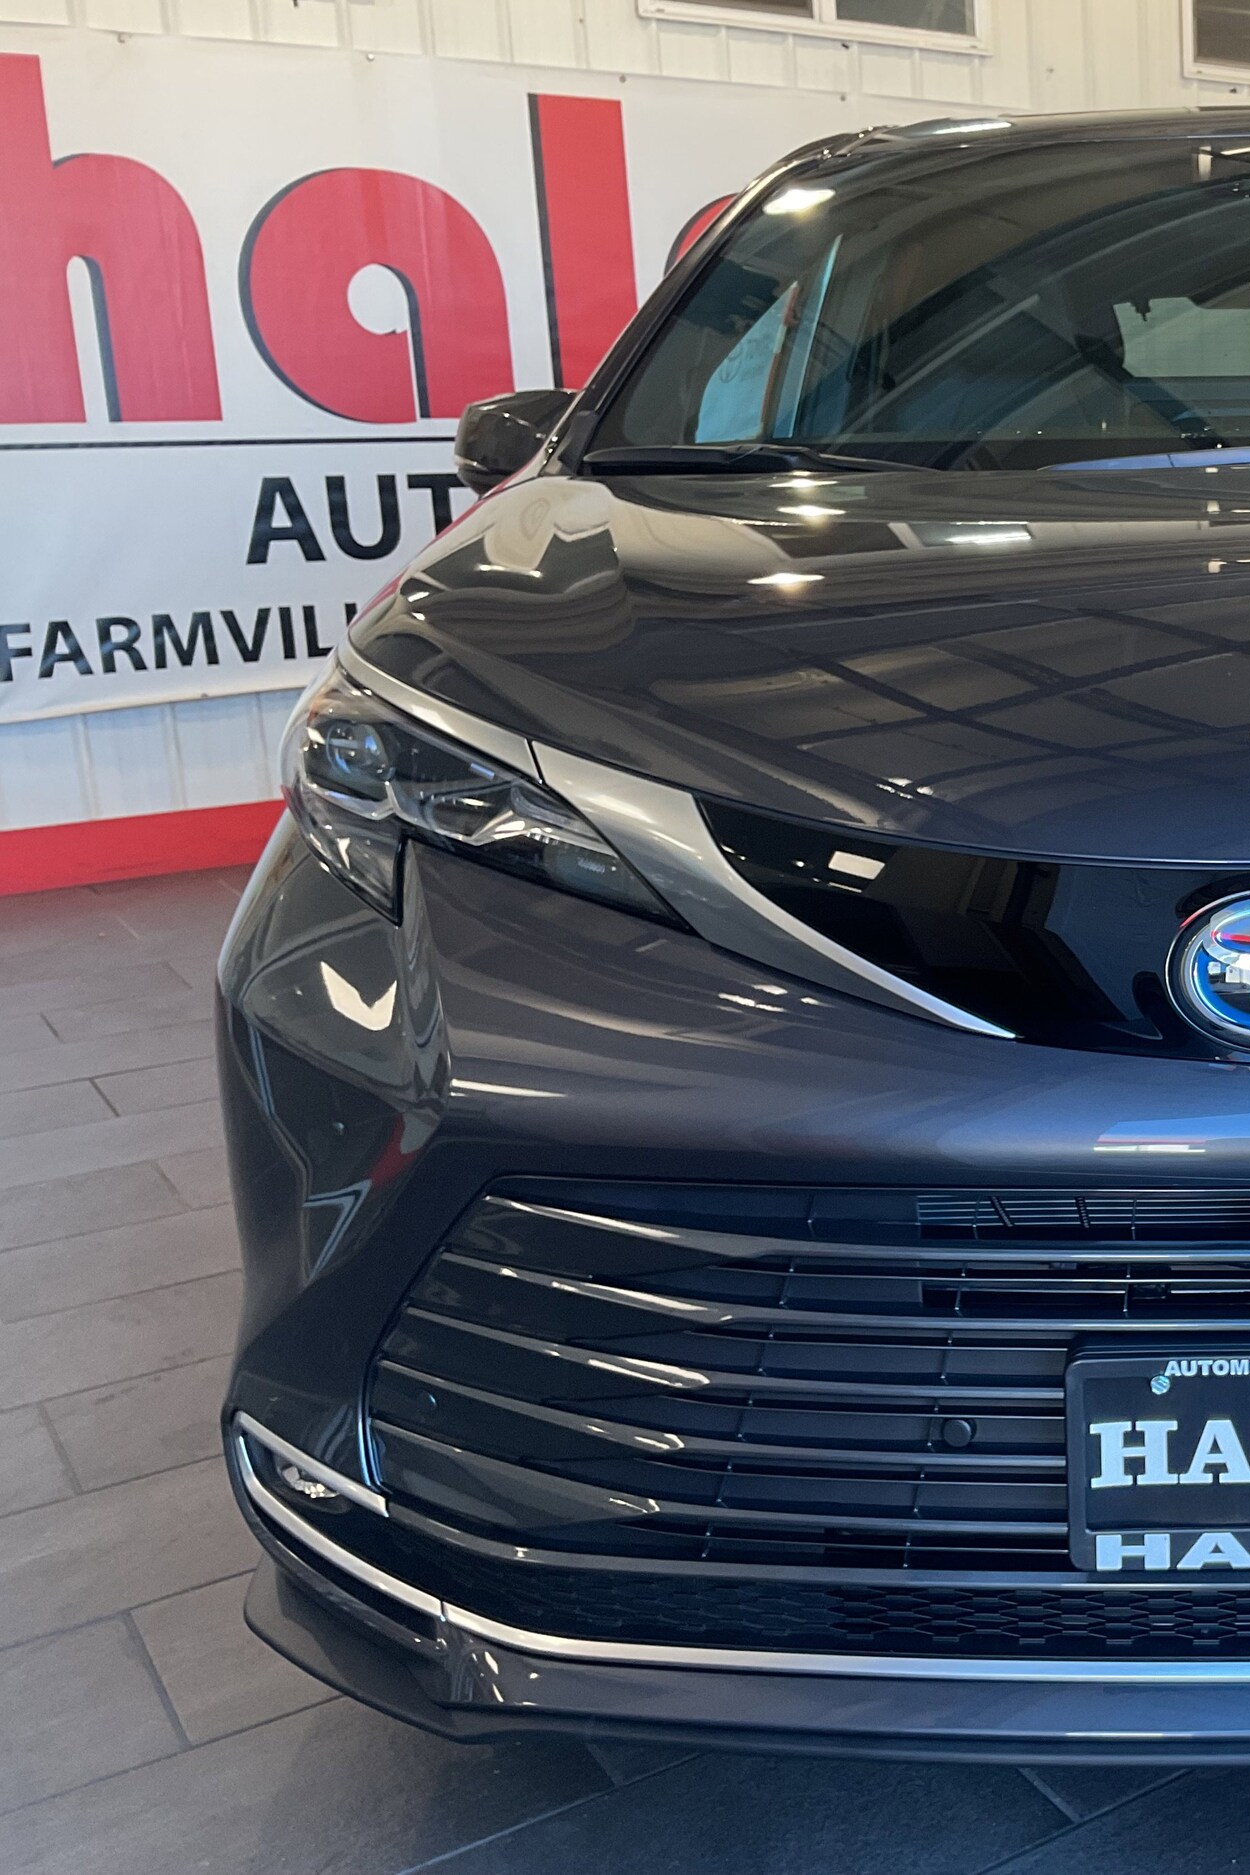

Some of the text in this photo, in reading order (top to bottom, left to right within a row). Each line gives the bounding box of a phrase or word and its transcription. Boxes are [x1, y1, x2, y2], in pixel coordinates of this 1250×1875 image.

[0, 54, 738, 424] hal
[246, 473, 468, 565] AUT
[0, 603, 357, 682] FARMVIL
